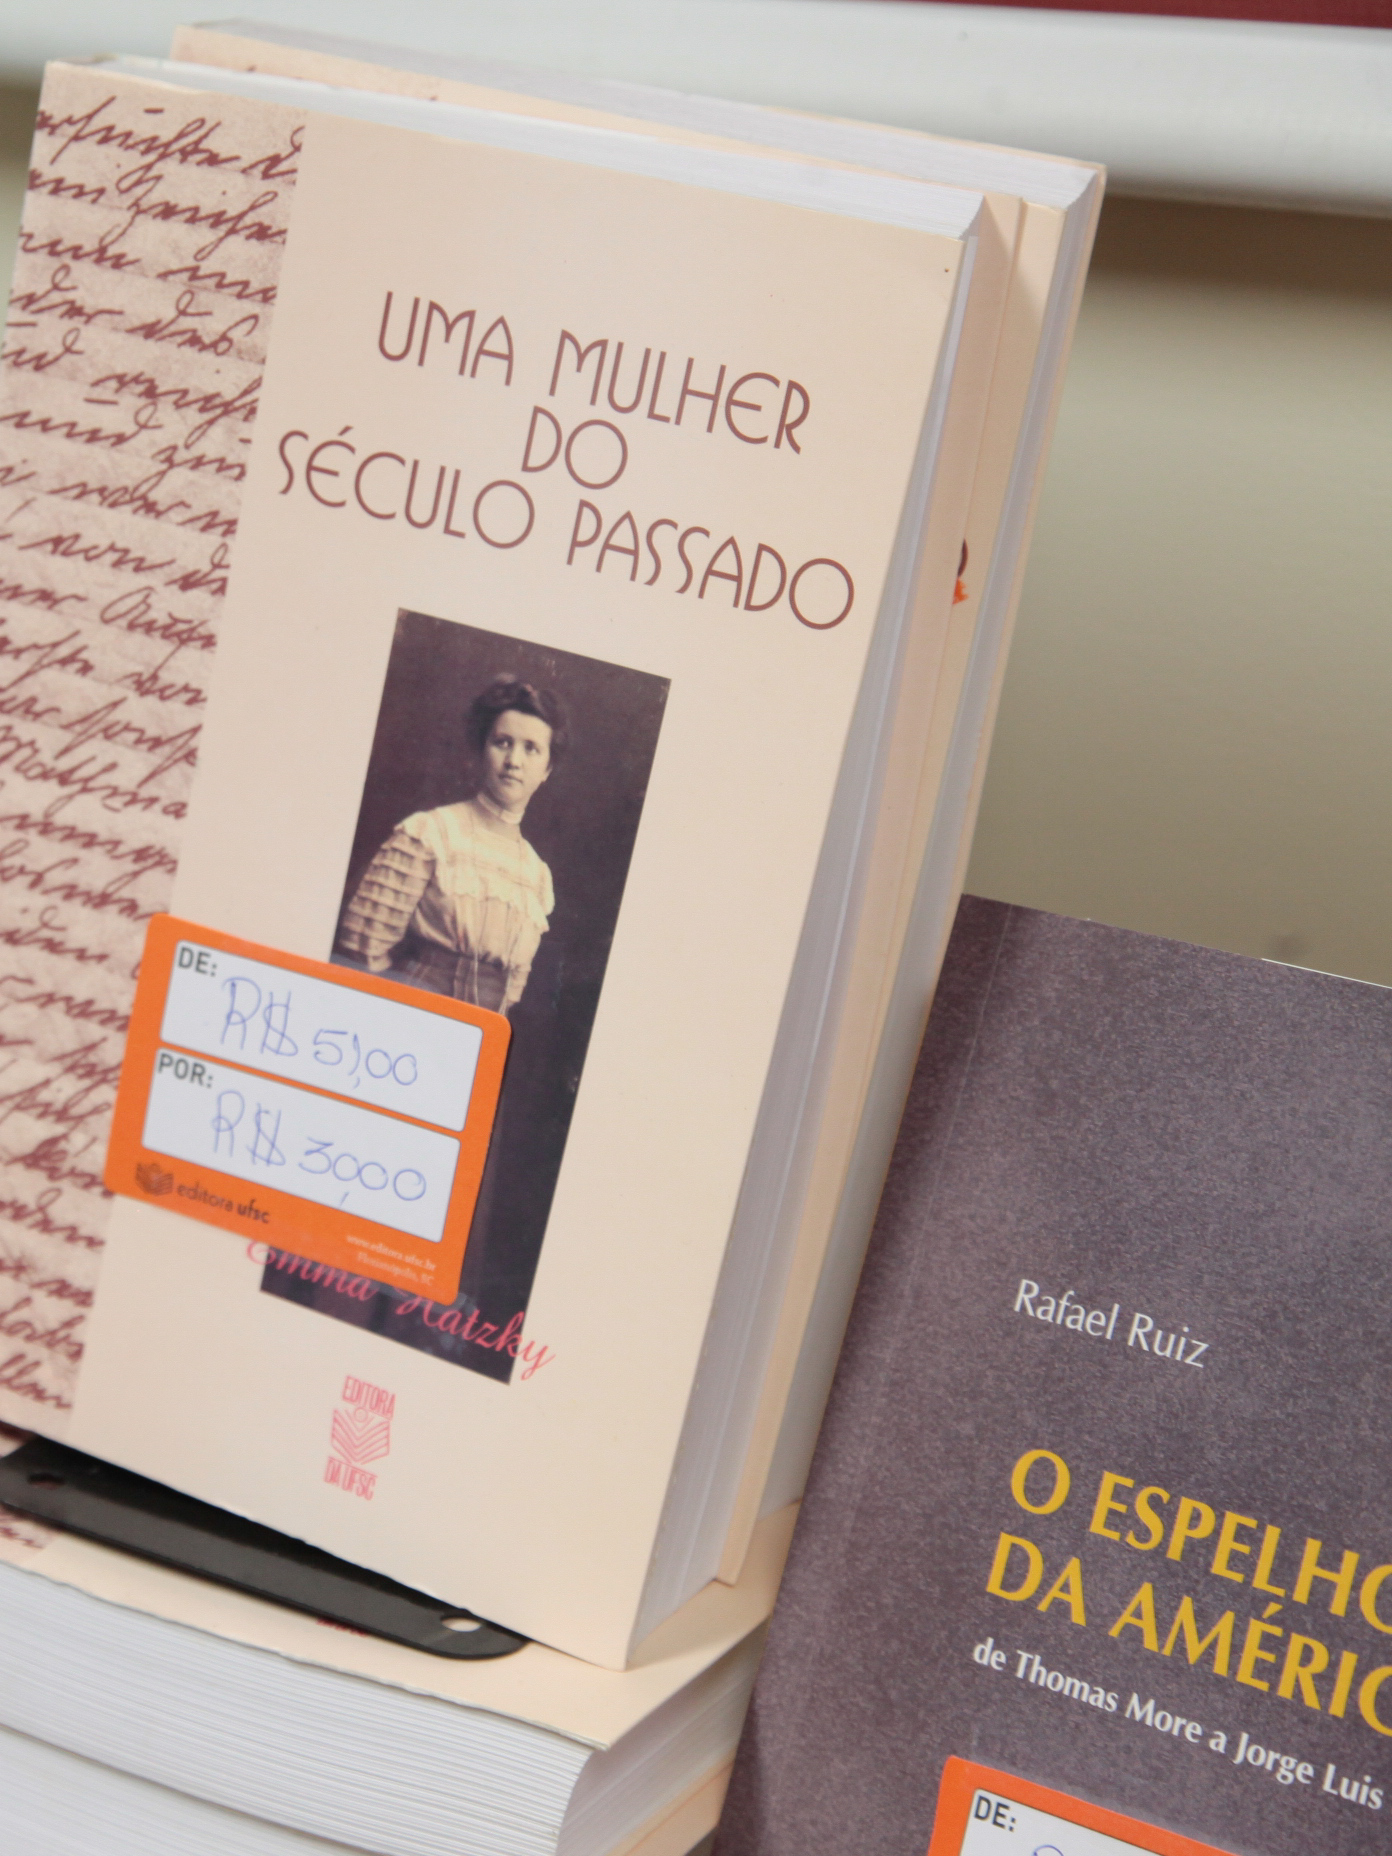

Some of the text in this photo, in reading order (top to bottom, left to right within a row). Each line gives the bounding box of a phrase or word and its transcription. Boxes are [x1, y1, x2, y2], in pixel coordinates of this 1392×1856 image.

[378, 291, 513, 386] UMA
[548, 329, 811, 455] MULHER
[521, 404, 629, 490] DO
[278, 425, 536, 549] SÉCULO
[565, 499, 855, 630] PASSADO
[177, 945, 218, 977] DE:
[157, 1053, 214, 1089] POR:
[176, 1180, 271, 1224] editora ufsc
[1013, 1278, 1210, 1369] Rafael Ruiz
[341, 1375, 396, 1421] EDITORA
[1011, 1448, 1071, 1515] O
[986, 1531, 1087, 1627] DA
[973, 1637, 1384, 1810] de Thomas More a Jorge Luis
[973, 1795, 1017, 1833] DE:
